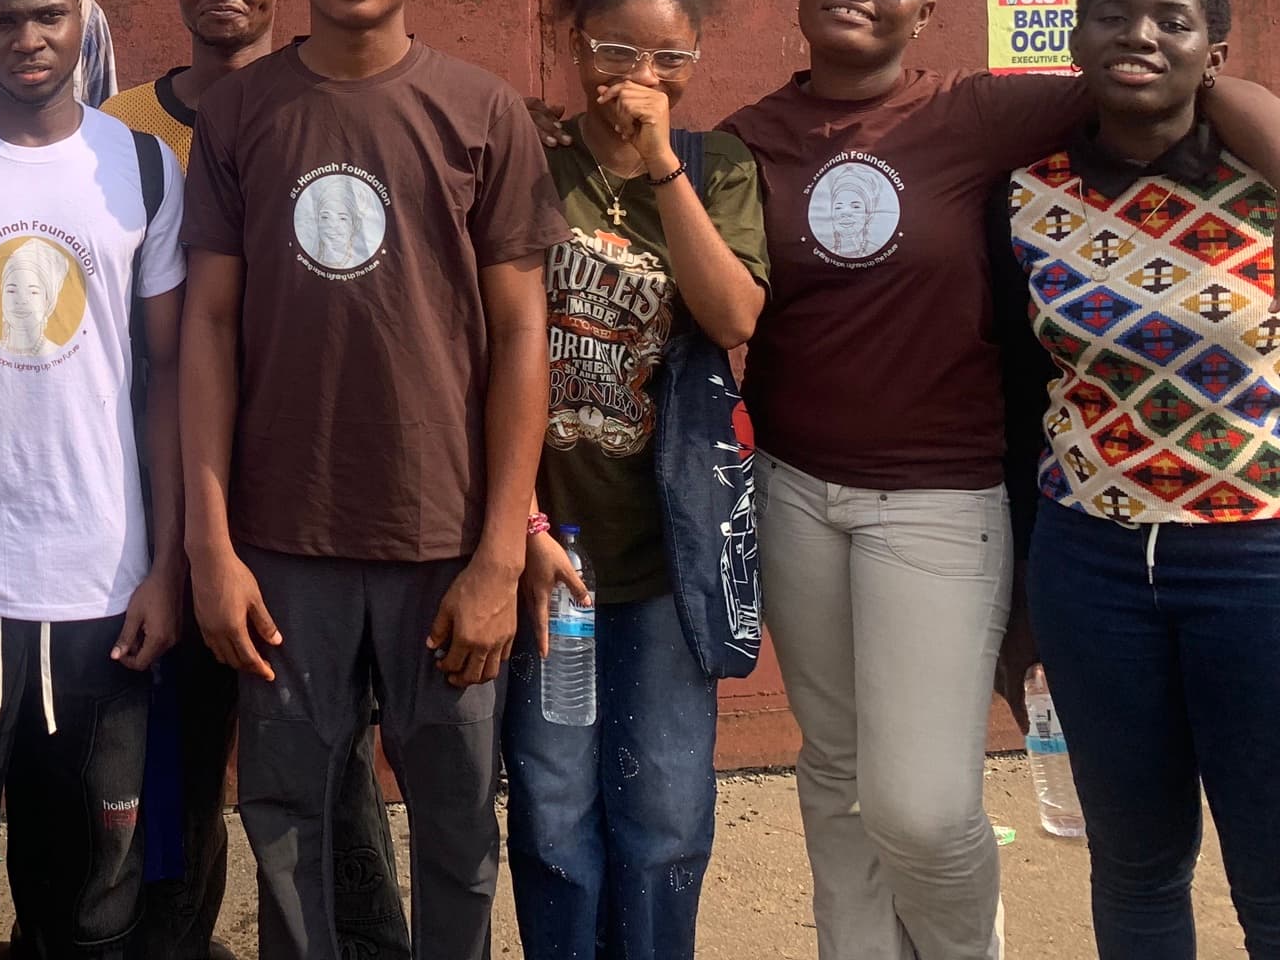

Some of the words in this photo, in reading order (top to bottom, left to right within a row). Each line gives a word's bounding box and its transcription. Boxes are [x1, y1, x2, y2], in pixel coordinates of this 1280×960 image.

[1011, 56, 1058, 64] EXECUTIVE
[290, 187, 301, 200] St.
[297, 162, 340, 187] Hannah
[341, 162, 392, 206] Foundation
[812, 152, 848, 181] Hannah
[850, 151, 905, 191] Foundation
[32, 220, 96, 276] Foundation
[547, 240, 667, 326] RULES
[569, 297, 617, 327] MADE
[14, 362, 40, 374] Lighting
[40, 361, 51, 372] Up
[51, 358, 62, 367] The
[549, 369, 643, 422] BONES
